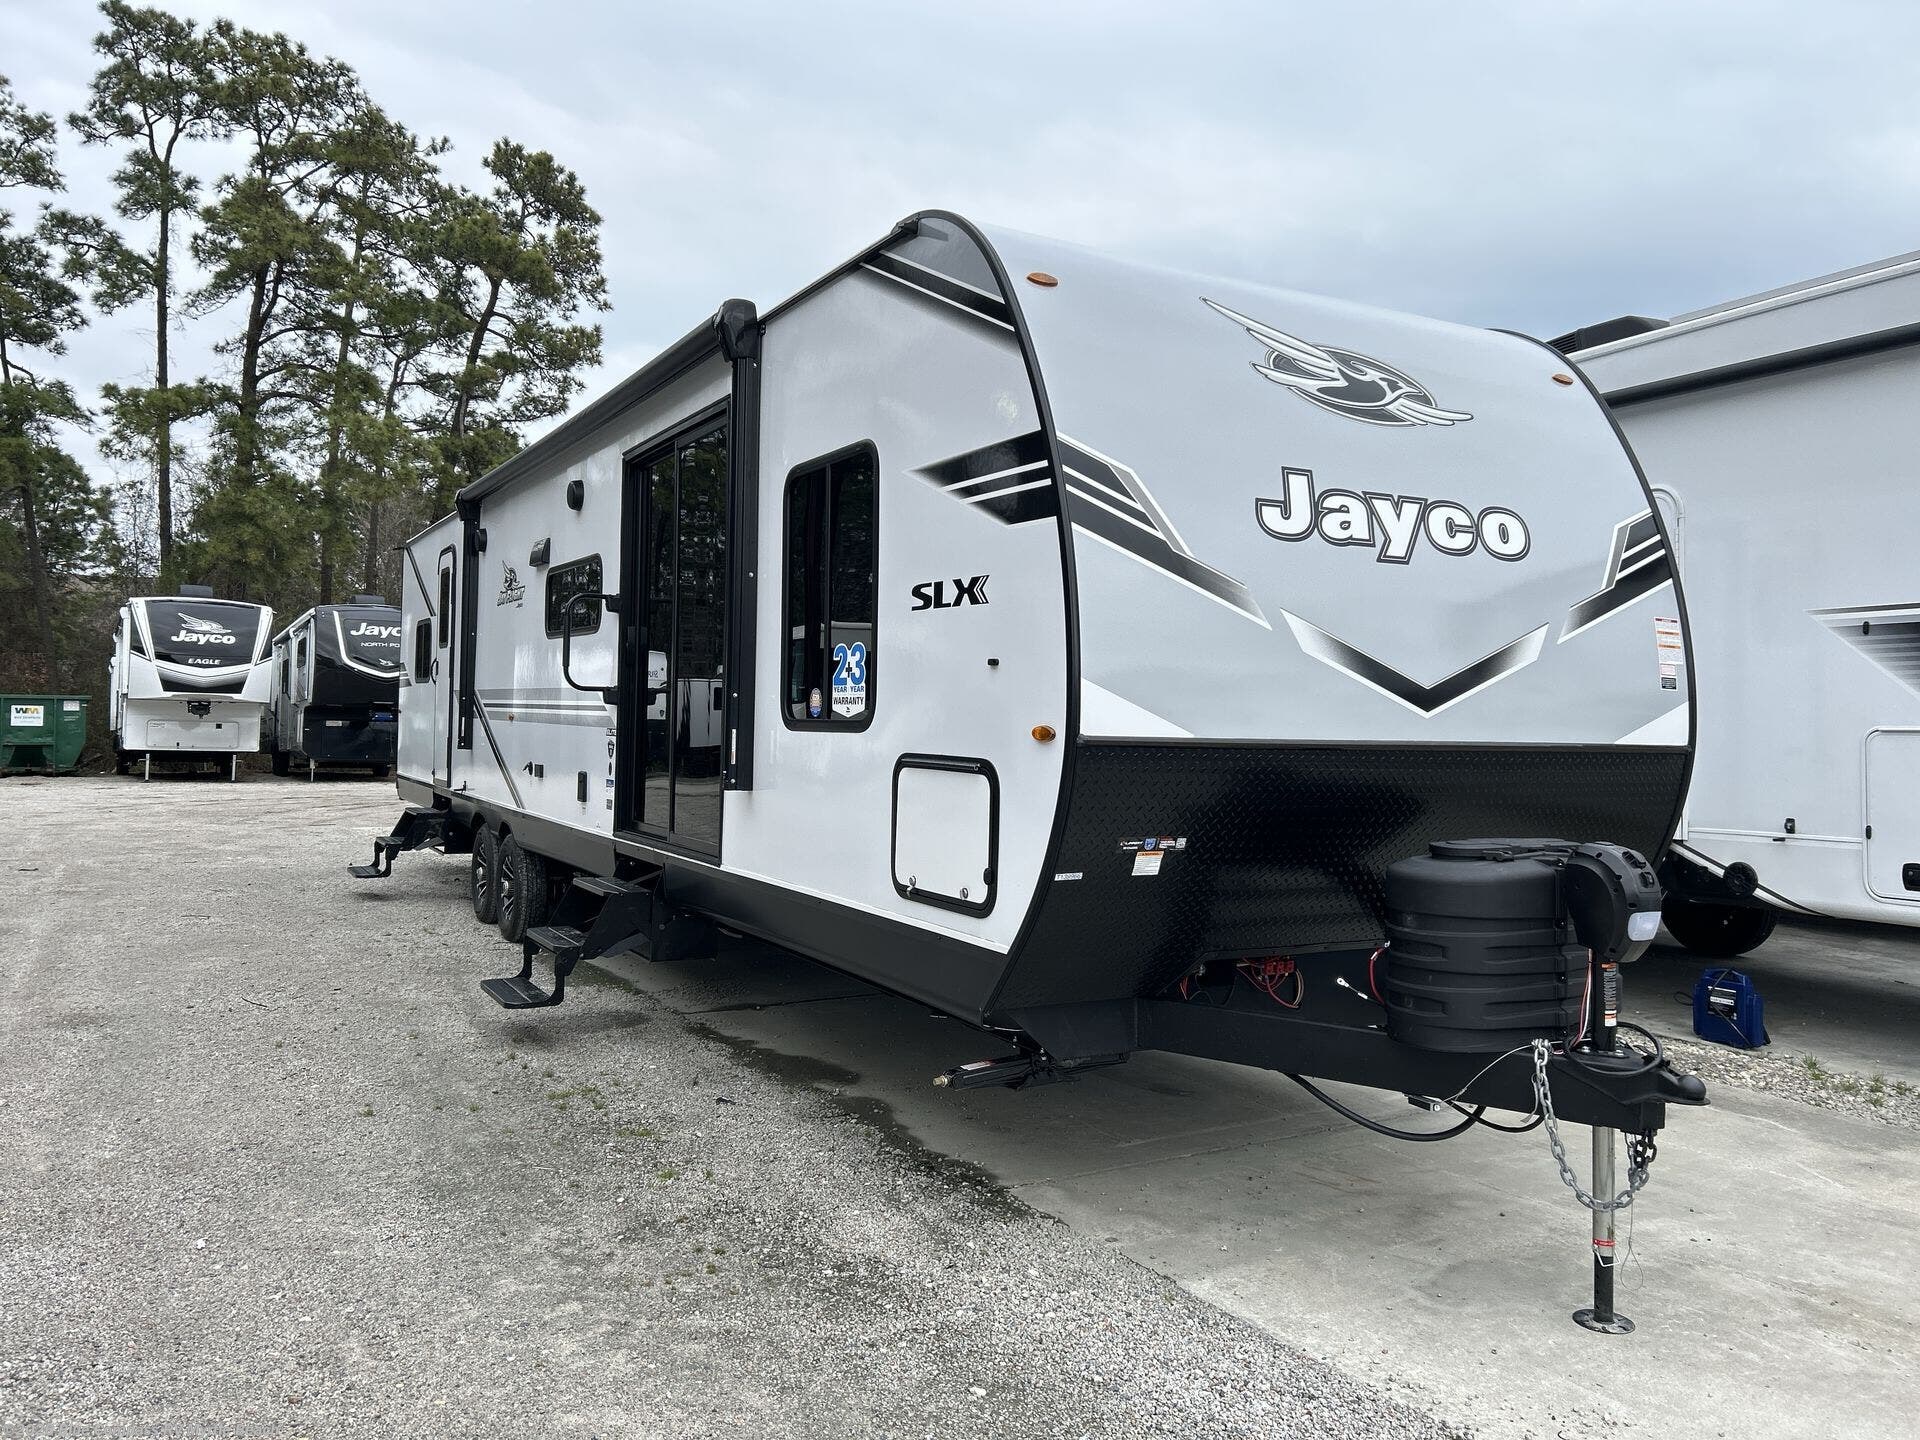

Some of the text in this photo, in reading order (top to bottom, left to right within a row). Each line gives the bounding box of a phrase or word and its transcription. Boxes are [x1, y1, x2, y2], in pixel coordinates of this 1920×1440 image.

[1255, 466, 1531, 565] Jayco
[911, 575, 990, 611] SLX
[171, 630, 236, 645] Jayco
[833, 697, 864, 705] WARRANTY
[15, 707, 39, 715] WM
